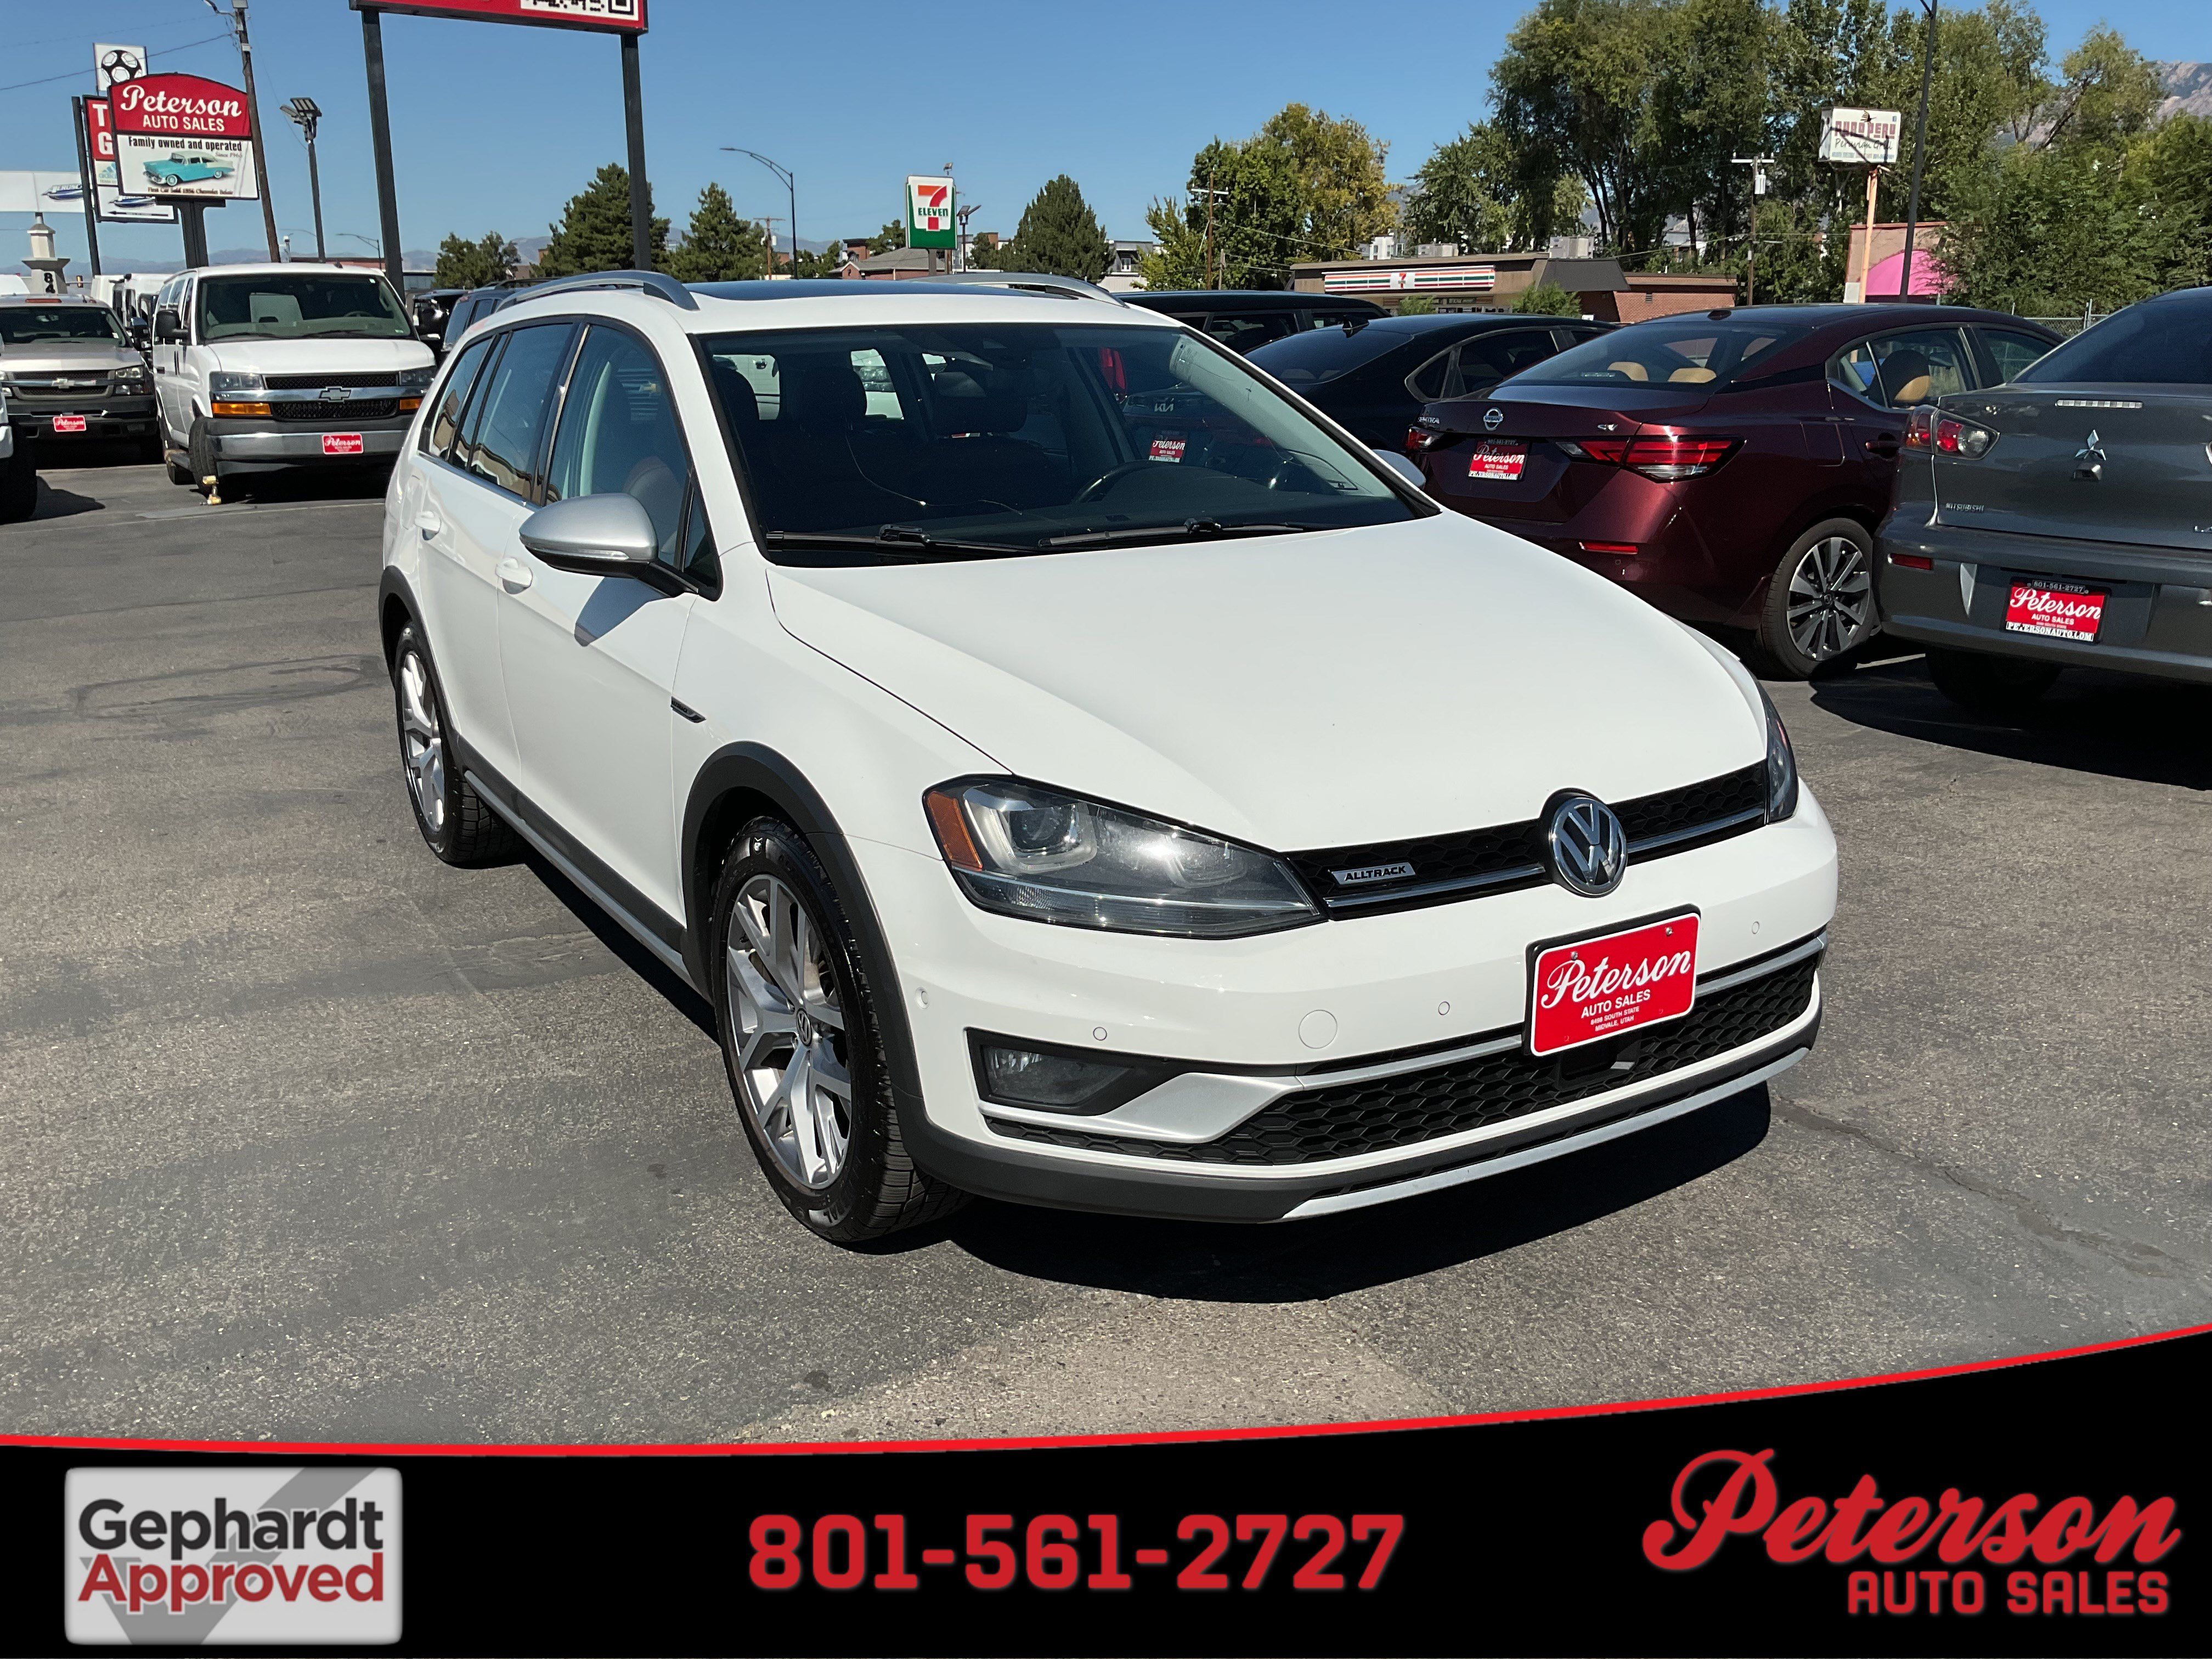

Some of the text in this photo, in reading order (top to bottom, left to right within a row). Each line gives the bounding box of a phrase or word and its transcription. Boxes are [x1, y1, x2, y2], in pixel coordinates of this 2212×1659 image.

[120, 84, 241, 117] Peterson
[143, 114, 225, 132] AUTO SALES
[128, 136, 242, 151] Family owned and operated
[918, 185, 947, 230] 7
[324, 437, 361, 447] Peterson
[1472, 444, 1525, 465] Peterson
[2033, 580, 2084, 593] 801-561-2727
[2010, 586, 2102, 620] Peterson
[2031, 613, 2051, 622] AUTO
[2051, 616, 2075, 625] SALES
[1344, 865, 1406, 882] ALLTRACK
[1541, 950, 1691, 1009] Peterson
[1581, 989, 1651, 1019] AUTO SALES
[1604, 1011, 1623, 1021] SOUTH
[1623, 1006, 1640, 1015] STATE
[1620, 1014, 1634, 1024] UTAH
